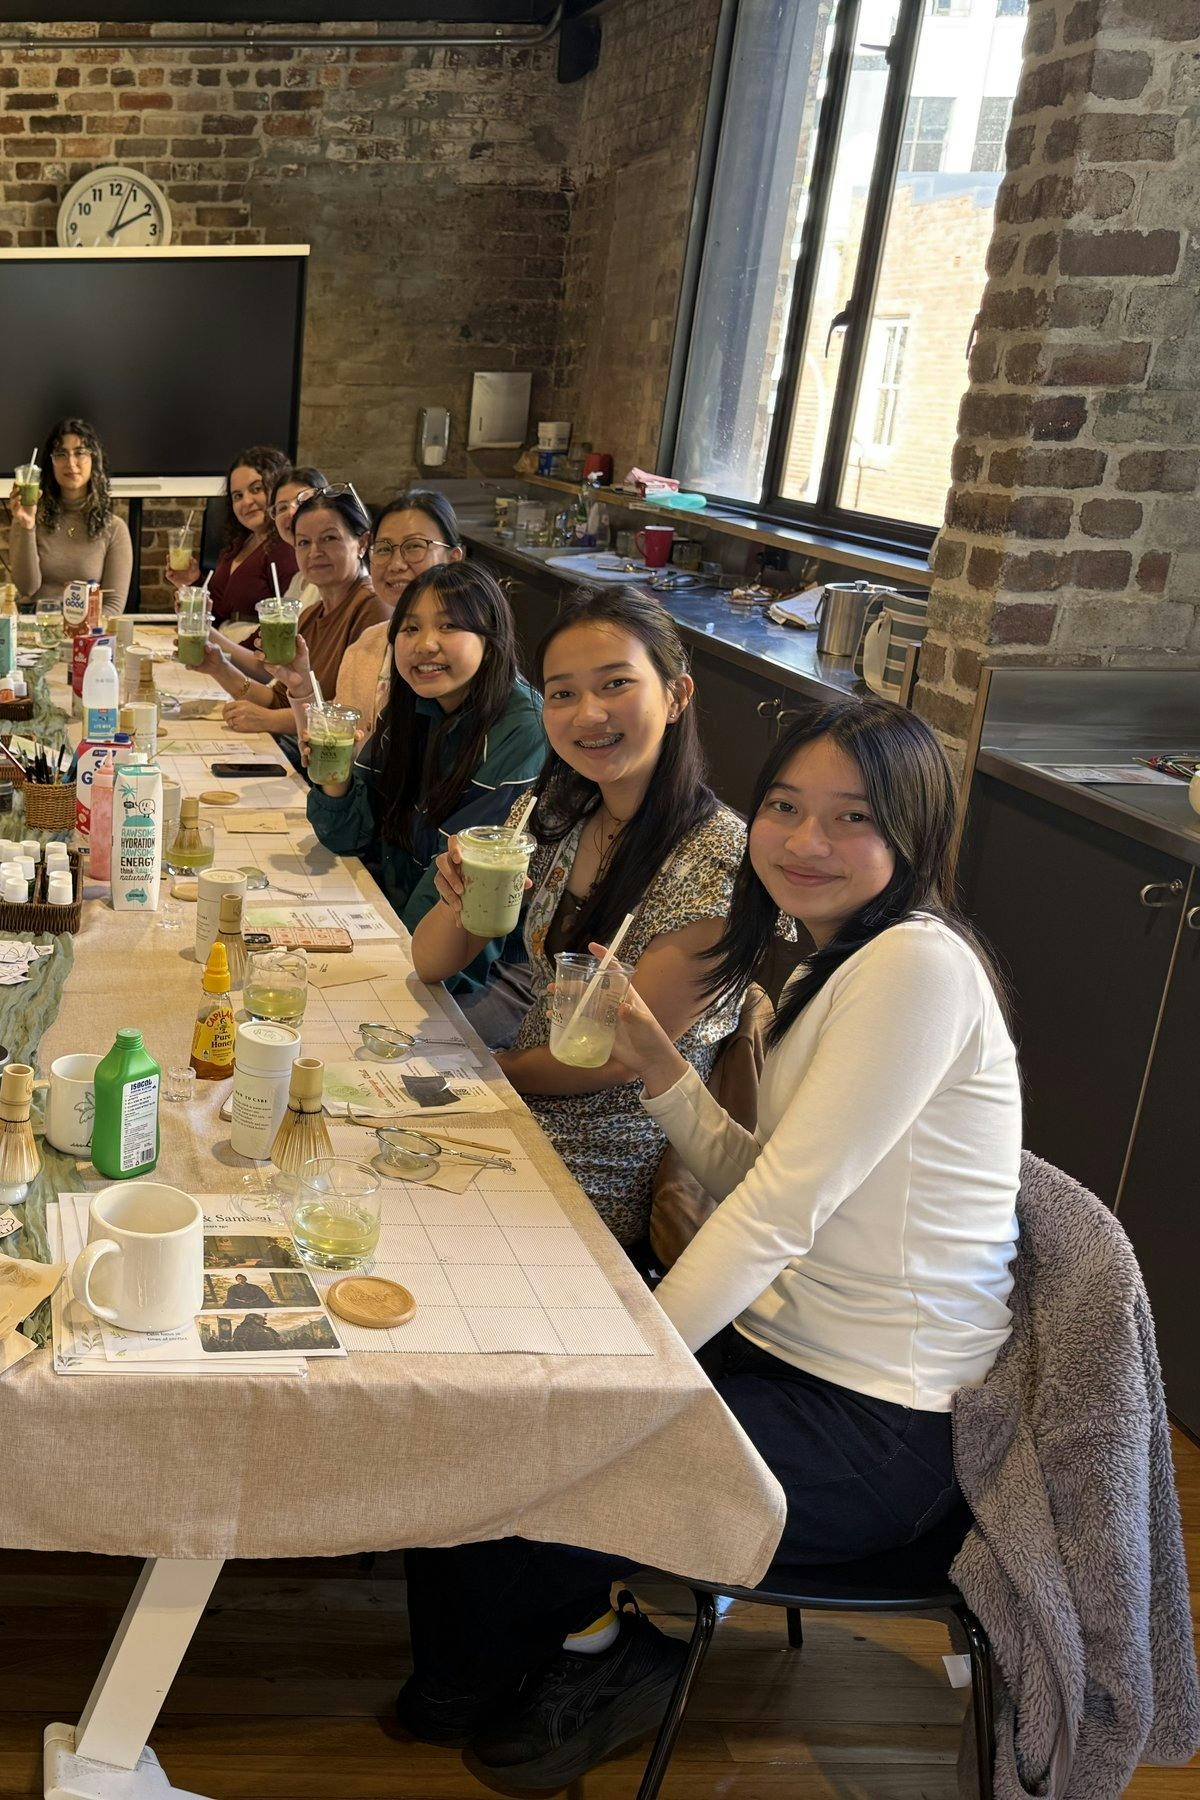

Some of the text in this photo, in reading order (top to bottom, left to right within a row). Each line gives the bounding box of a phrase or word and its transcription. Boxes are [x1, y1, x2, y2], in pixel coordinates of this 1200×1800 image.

[92, 189, 102, 202] 11
[110, 183, 123, 196] 12
[133, 190, 138, 202] 1
[78, 203, 91, 216] 10
[144, 204, 152, 216] 2
[70, 223, 78, 235] 9
[149, 224, 157, 236] 3
[71, 592, 81, 601] So
[65, 597, 86, 609] Good
[121, 828, 155, 837] RAWSOME
[120, 837, 155, 849] HYDRATION
[121, 848, 154, 857] RAWSOME
[120, 856, 155, 867] ENERGY
[120, 867, 134, 875] think
[120, 873, 154, 883] naturally
[211, 1040, 233, 1049] Honey
[130, 1079, 153, 1091] ISOCOL
[202, 1214, 212, 1222] &
